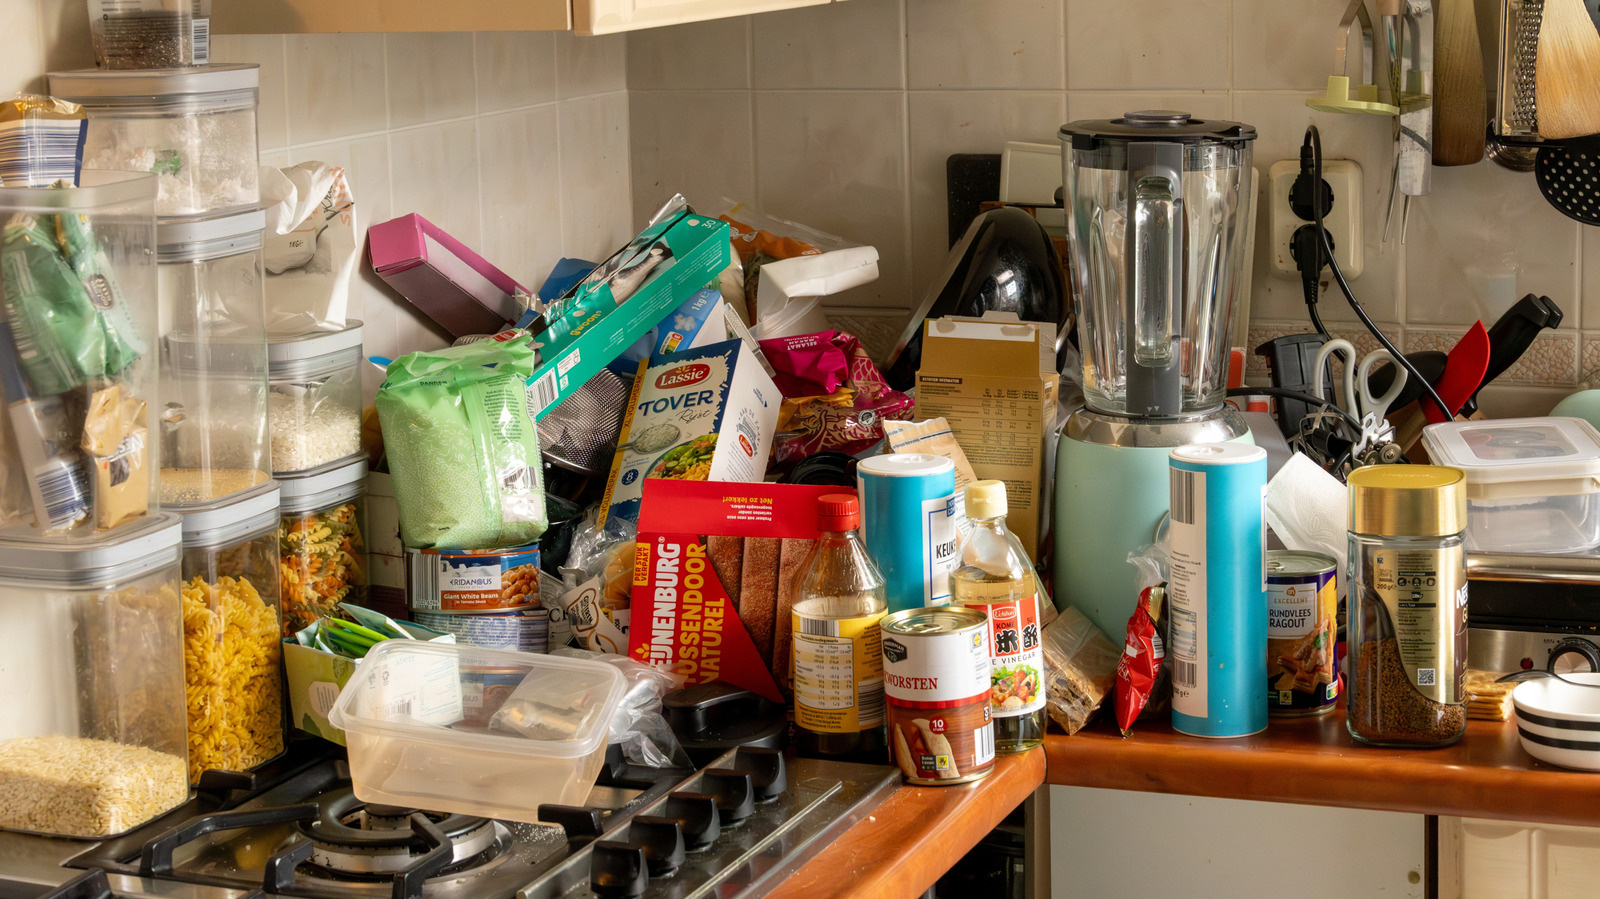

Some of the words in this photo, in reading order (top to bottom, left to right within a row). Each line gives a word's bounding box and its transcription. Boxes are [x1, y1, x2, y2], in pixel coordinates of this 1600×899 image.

[570, 313, 601, 336] gwoon
[787, 341, 817, 350] SELAMAT
[660, 369, 705, 386] Lassie
[626, 374, 643, 417] VOLUMEPAK
[638, 390, 714, 416] TOVER
[601, 469, 618, 513] VOLUMEPAK
[641, 547, 650, 582] VERPAKT
[650, 543, 681, 671] EIJNENBURG
[1269, 609, 1311, 618] RUNDVLEES
[996, 621, 1016, 630] KOME
[1269, 618, 1306, 628] RAGOUT
[699, 598, 725, 684] NATUREL
[1001, 652, 1036, 664] VINEGAR
[932, 719, 944, 728] 10
